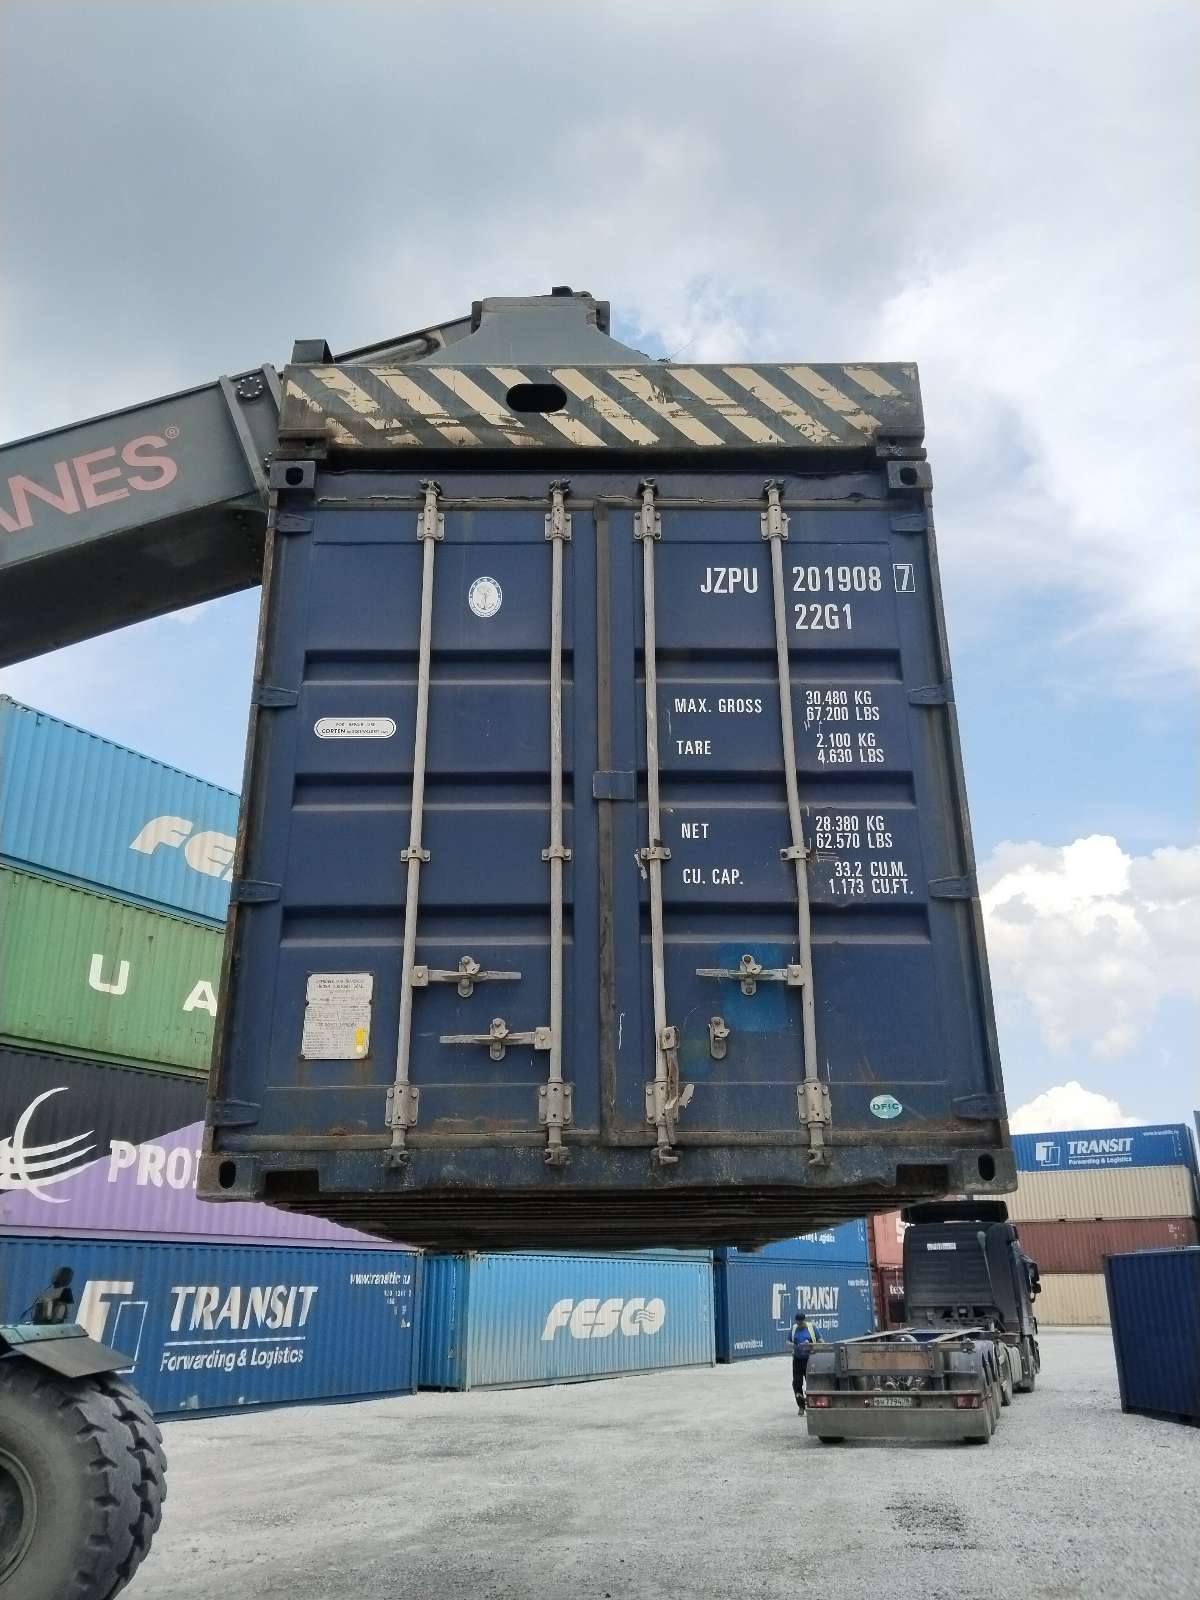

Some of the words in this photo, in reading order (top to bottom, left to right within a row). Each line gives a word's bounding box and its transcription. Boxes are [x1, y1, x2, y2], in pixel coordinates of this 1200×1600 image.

[700, 567, 758, 594] JZPU
[792, 566, 882, 592] 201908
[794, 603, 853, 630] 22G1
[674, 698, 712, 713] MAX.
[718, 699, 763, 713] GROSS
[805, 690, 848, 705] 30.480
[854, 691, 872, 705] KG
[806, 706, 849, 721] 67.200
[855, 707, 880, 721] LBS
[676, 741, 712, 755] TARE
[816, 733, 851, 748] 2.100
[858, 733, 876, 747] KG
[817, 749, 853, 763] 4.630
[859, 749, 885, 763] LBS
[681, 823, 710, 839] NET
[815, 816, 859, 832] 28.380
[866, 816, 885, 831] KG
[816, 833, 860, 849] 62.570
[868, 833, 893, 848] LBS
[682, 869, 706, 885] CU.
[711, 869, 744, 885] CAP.
[834, 862, 862, 877] 33.2
[829, 879, 865, 894] 1.173
[1067, 1137, 1134, 1155] TRANSIT
[796, 1286, 840, 1311] TRANSIT
[170, 1285, 319, 1332] TRANSIT
[541, 1298, 667, 1341] FESCO
[159, 1349, 236, 1373] Forwarding
[237, 1348, 248, 1367] &
[250, 1346, 304, 1369] Logistics
